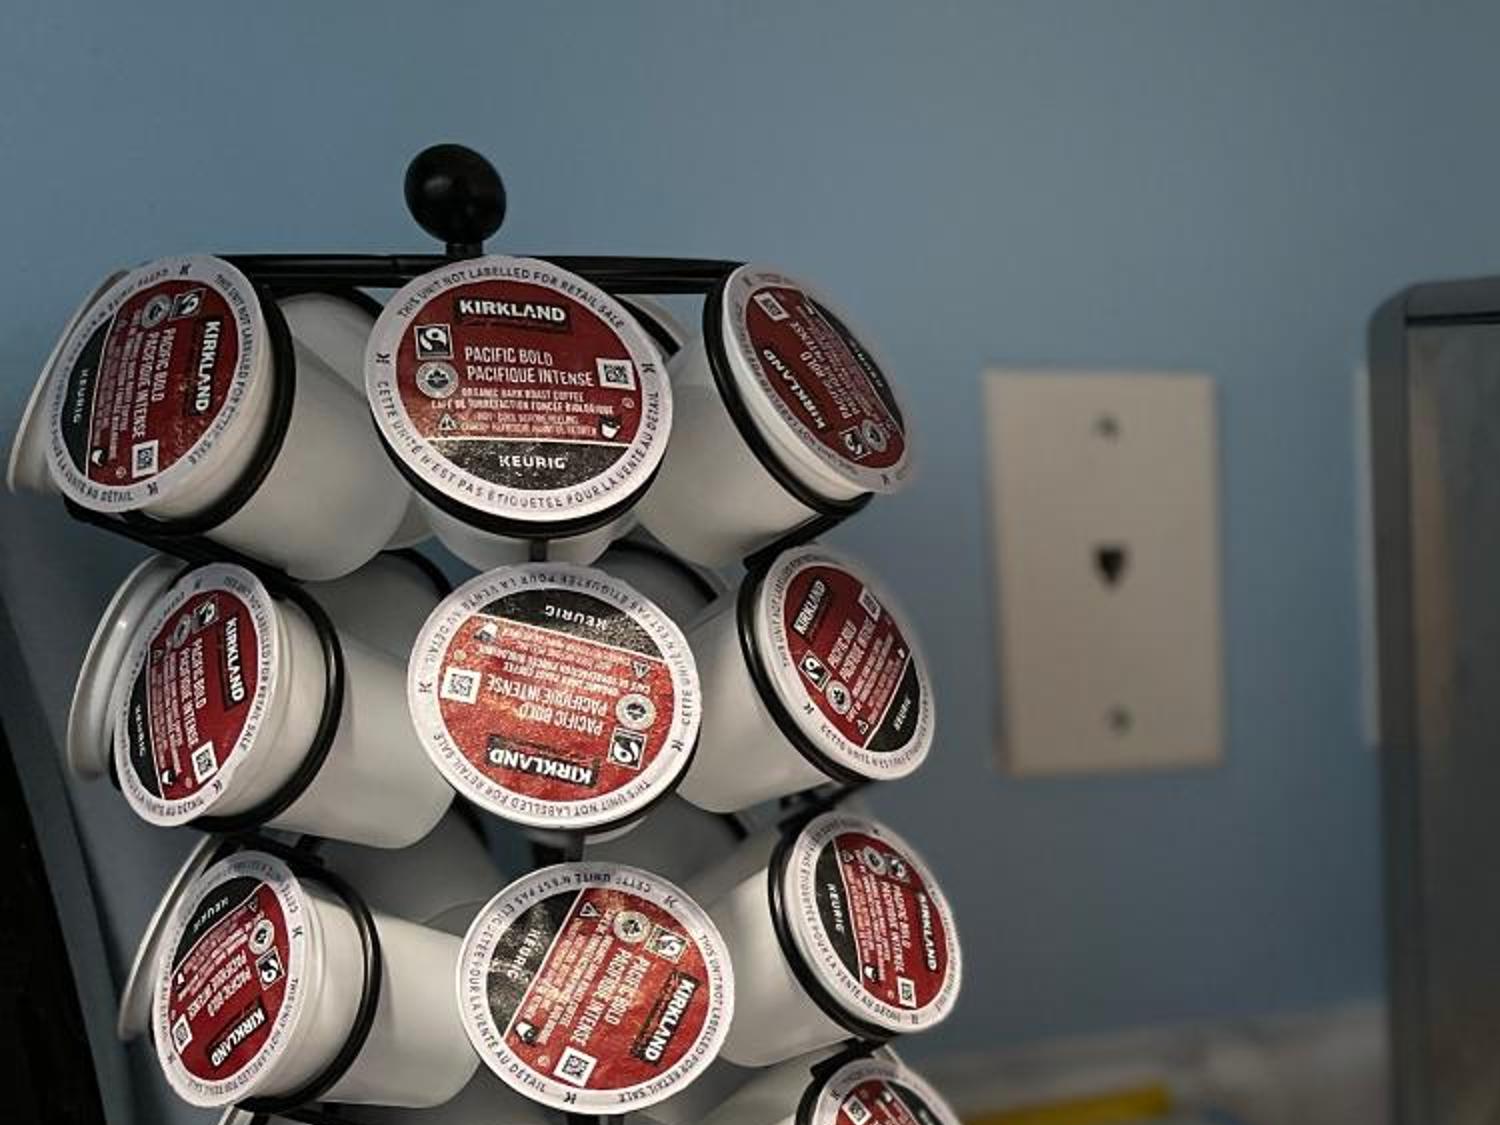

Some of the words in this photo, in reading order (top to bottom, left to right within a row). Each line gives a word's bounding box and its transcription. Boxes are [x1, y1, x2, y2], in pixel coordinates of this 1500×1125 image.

[469, 267, 530, 280] LABELLED
[533, 270, 558, 286] FOR
[459, 299, 567, 323] KIRKLAND
[159, 328, 177, 374] PACIFIC
[195, 320, 221, 412] KIRKLAND
[464, 346, 517, 363] PACIFIC
[520, 348, 553, 367] BOLD
[467, 365, 536, 384] PACIFIQUE
[538, 368, 594, 387] INTENSE
[764, 349, 825, 429] KIRKLAND
[132, 385, 152, 439] INTENSE
[499, 455, 565, 470] KEURIG
[544, 604, 609, 631] KEURIG
[793, 580, 827, 635] KIRKLAND
[225, 617, 245, 701] KIRKLAND
[487, 674, 542, 700] INTENSE
[556, 711, 604, 736] PACIFIC
[489, 747, 593, 785] KIRKLAND
[826, 882, 845, 934] KEURIG
[507, 927, 541, 981] KEURIG
[918, 892, 937, 971] KIRKLAND
[623, 955, 651, 999] PACIFIC
[211, 1007, 265, 1067] KIRKLAND
[570, 1002, 600, 1047] INTENSE
[644, 978, 696, 1062] KIRKLAND
